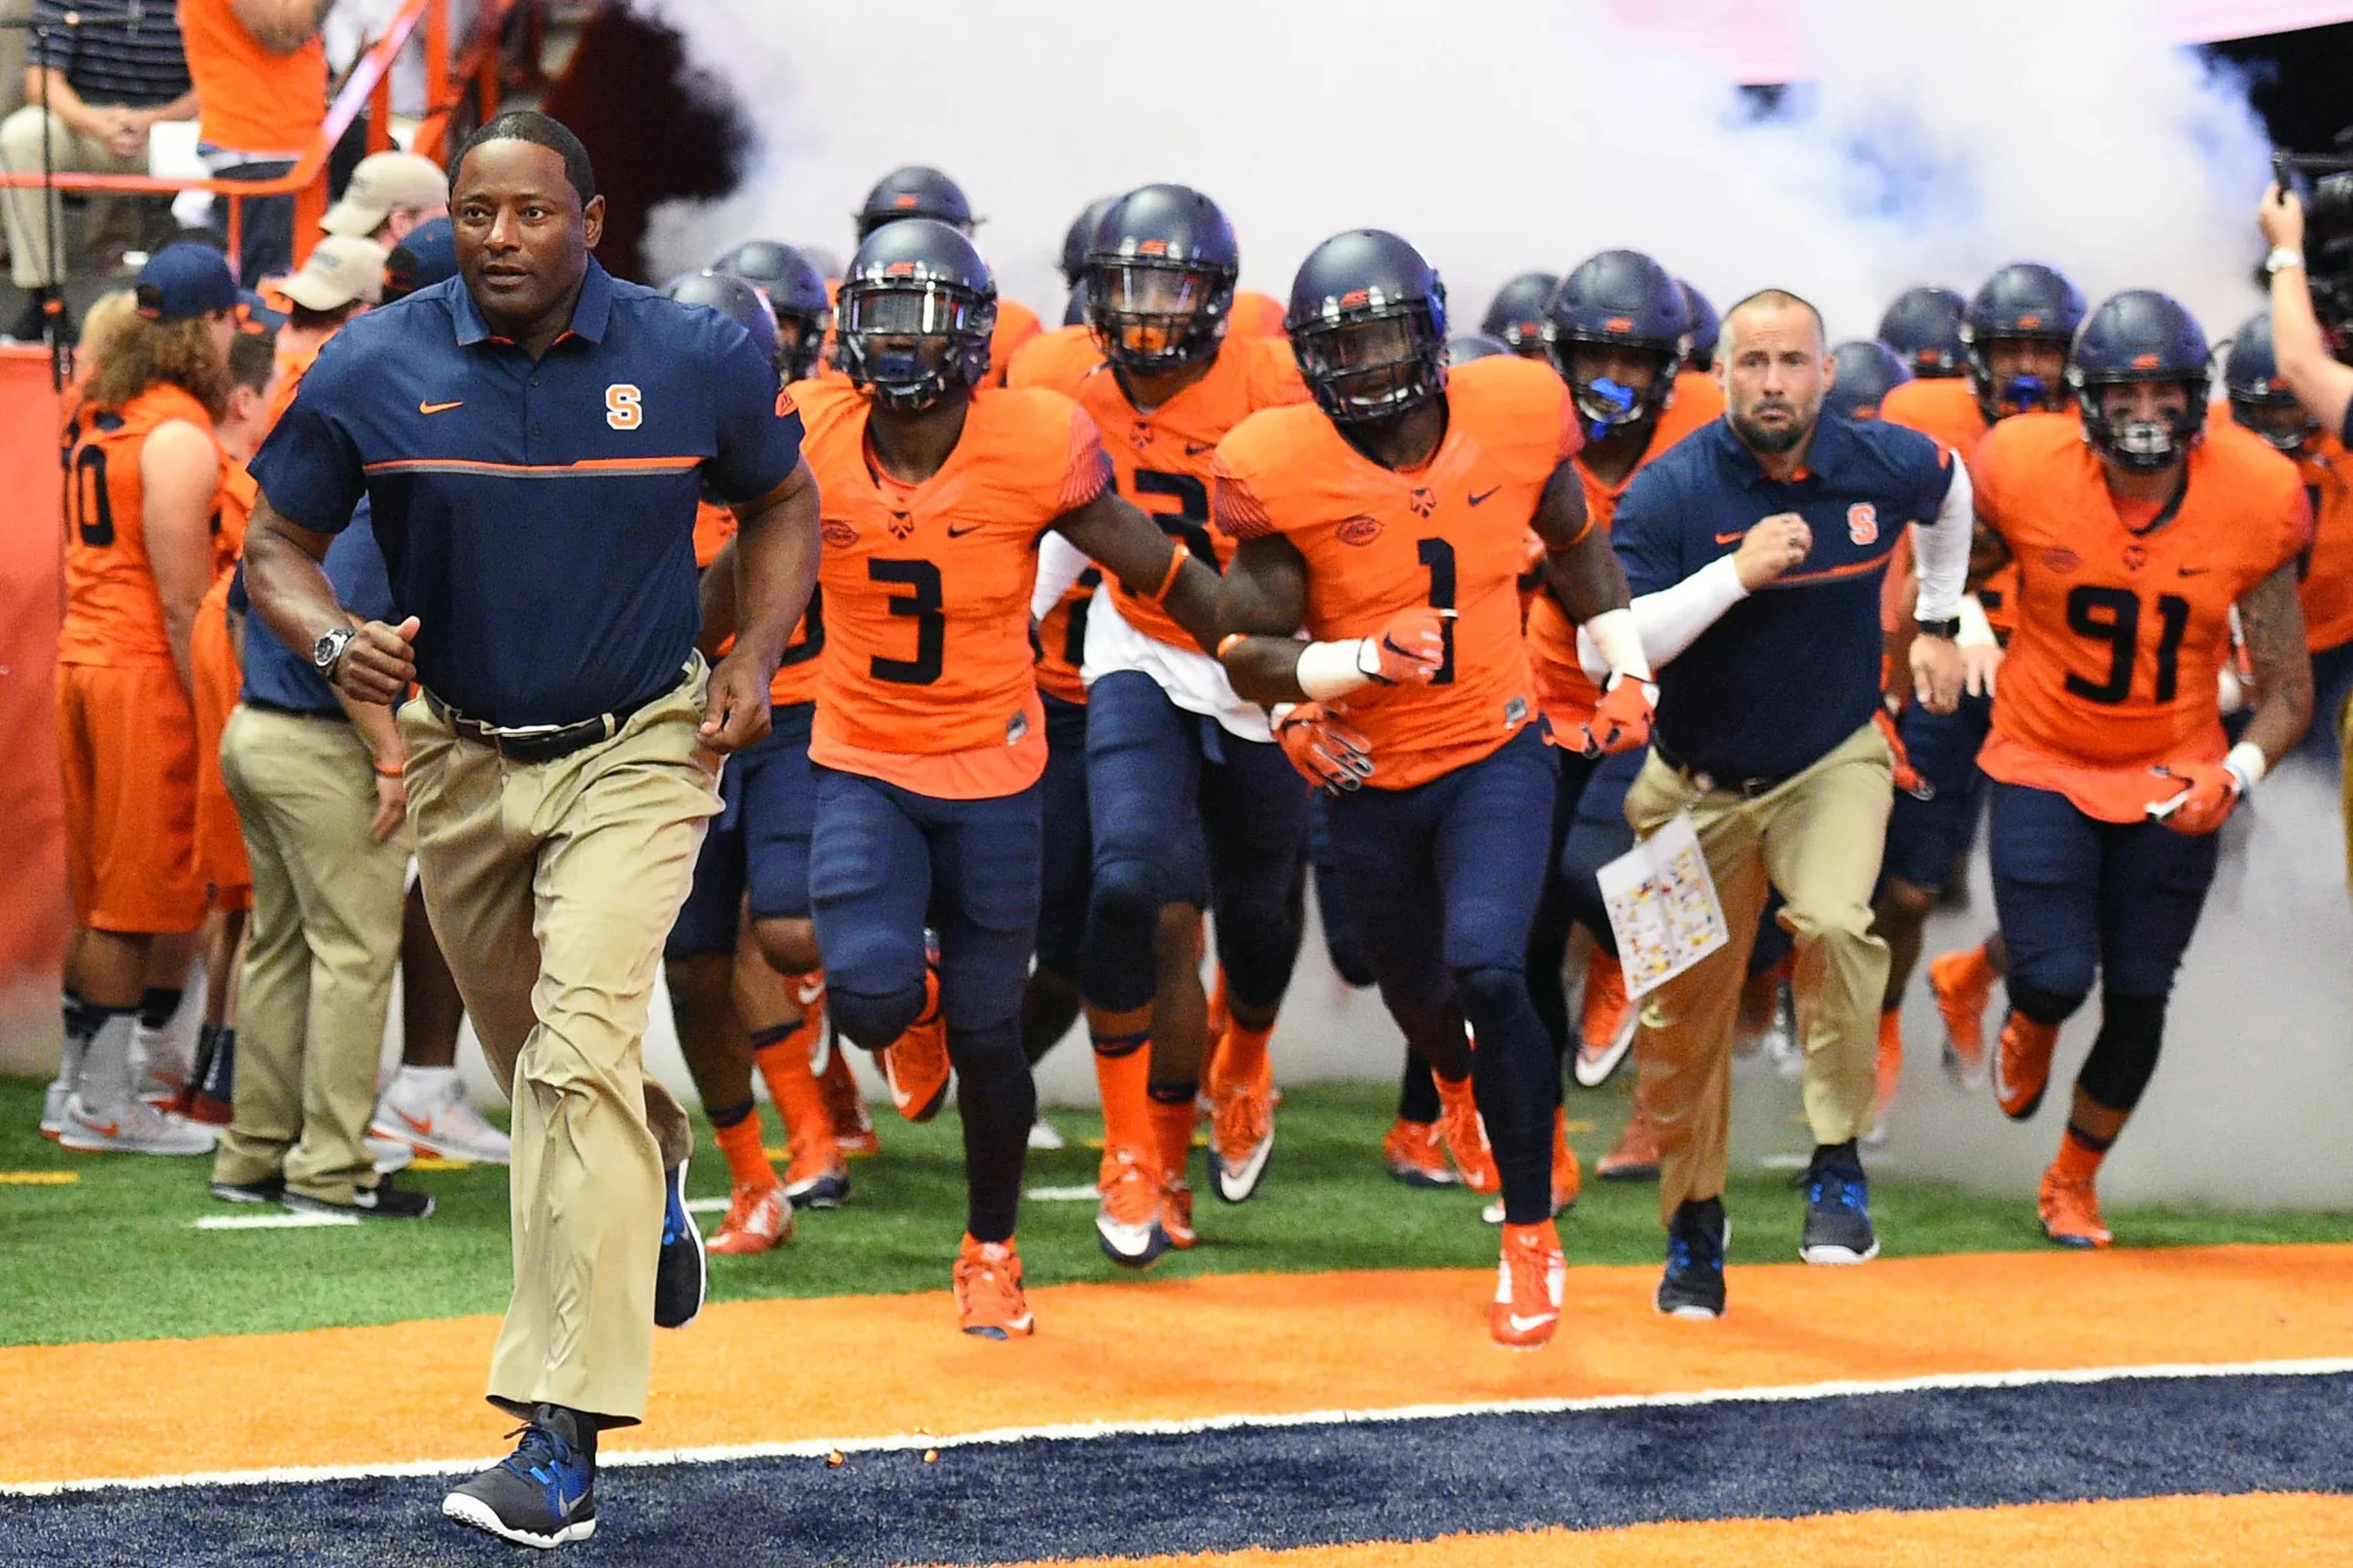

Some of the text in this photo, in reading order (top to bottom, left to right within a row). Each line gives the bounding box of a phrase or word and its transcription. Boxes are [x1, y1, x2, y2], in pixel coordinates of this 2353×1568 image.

[605, 384, 643, 430] S
[1846, 502, 1879, 545] S
[867, 557, 945, 685] 3
[1417, 537, 1457, 684] 1
[2064, 585, 2191, 705] 91
